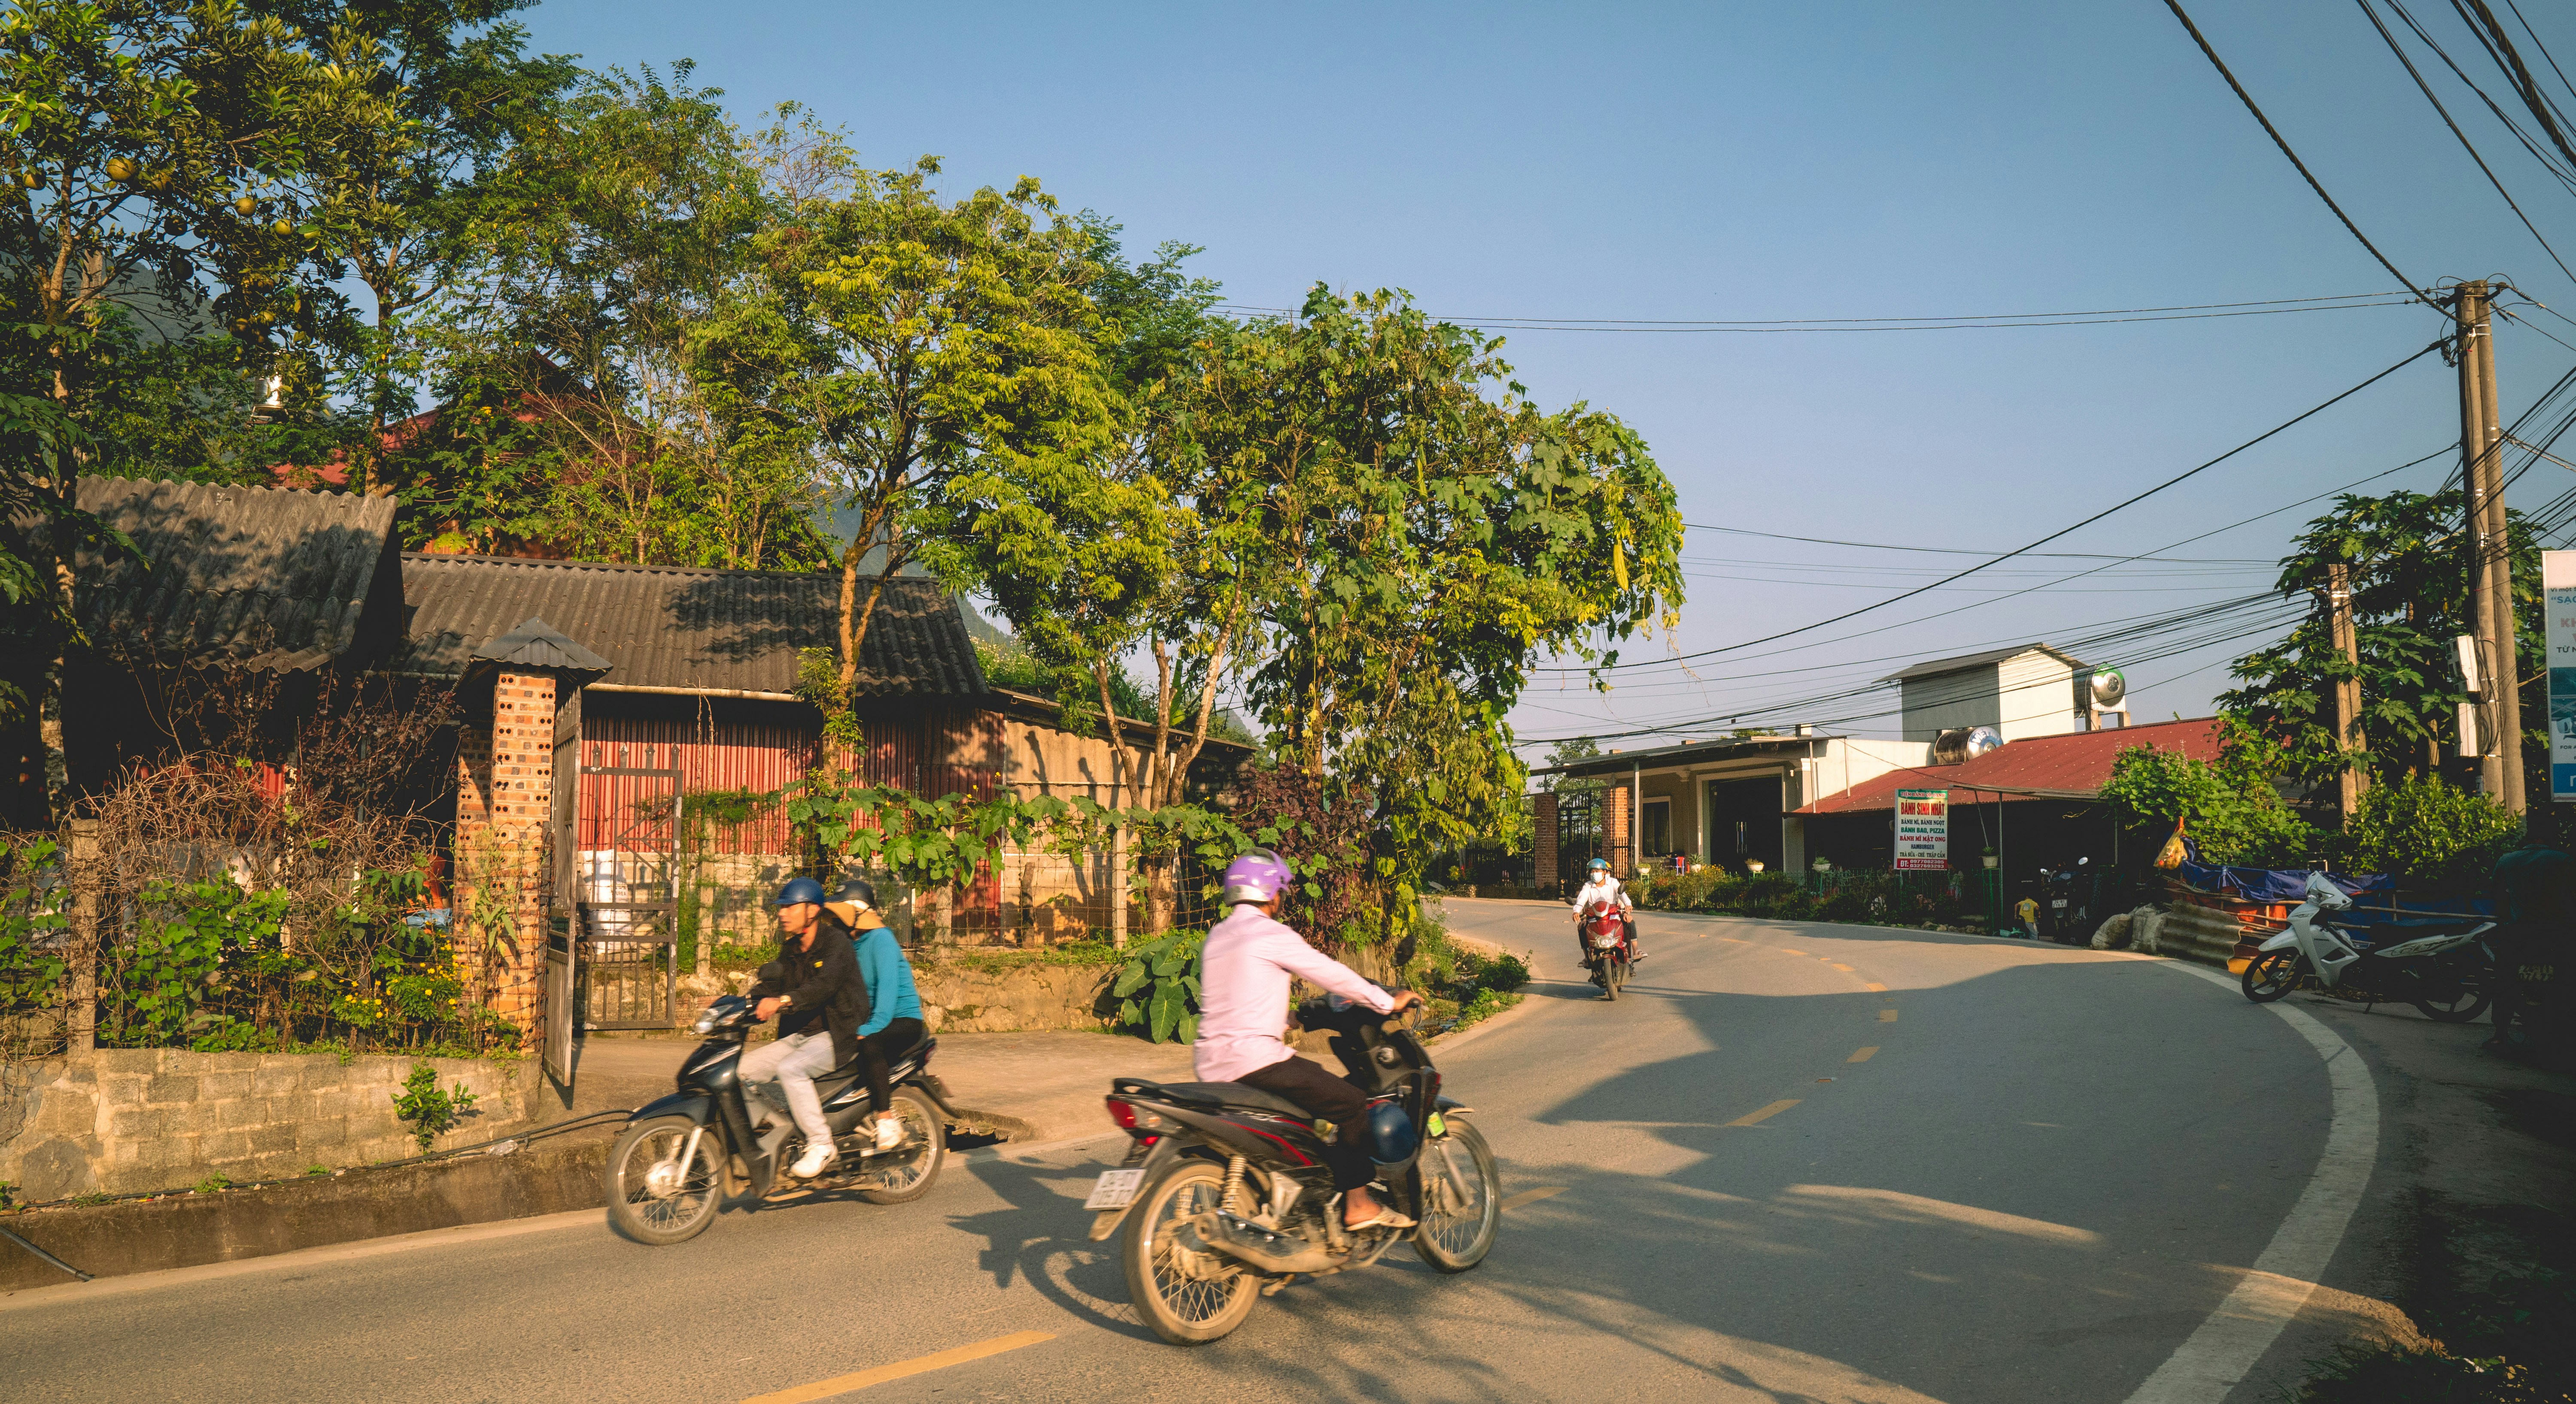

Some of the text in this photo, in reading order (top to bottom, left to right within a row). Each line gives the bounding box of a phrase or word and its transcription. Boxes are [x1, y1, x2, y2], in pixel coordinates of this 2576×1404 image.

[1901, 799, 1945, 819] BÁNH SINH NHẬT
